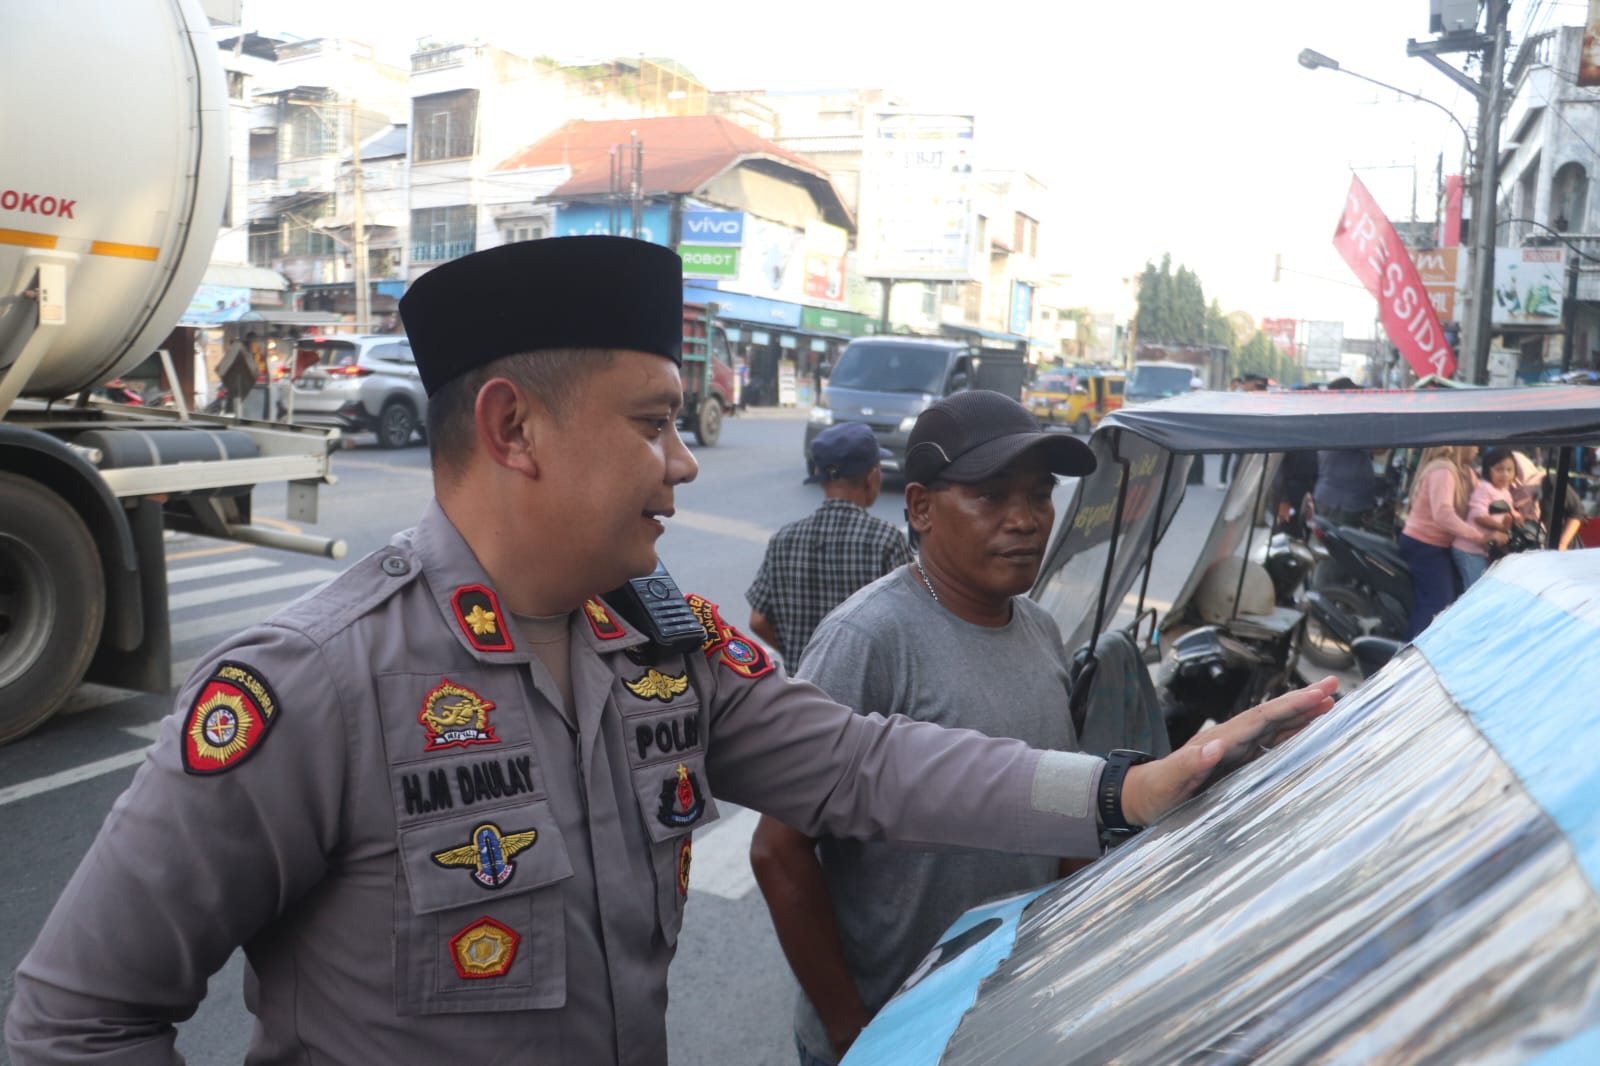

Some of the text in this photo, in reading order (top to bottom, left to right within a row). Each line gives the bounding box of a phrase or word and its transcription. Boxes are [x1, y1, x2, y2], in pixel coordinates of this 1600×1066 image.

[1, 190, 77, 219] OKOK
[688, 217, 739, 234] vivo
[683, 252, 733, 266] ROBOT
[456, 755, 534, 805] DAULAY
